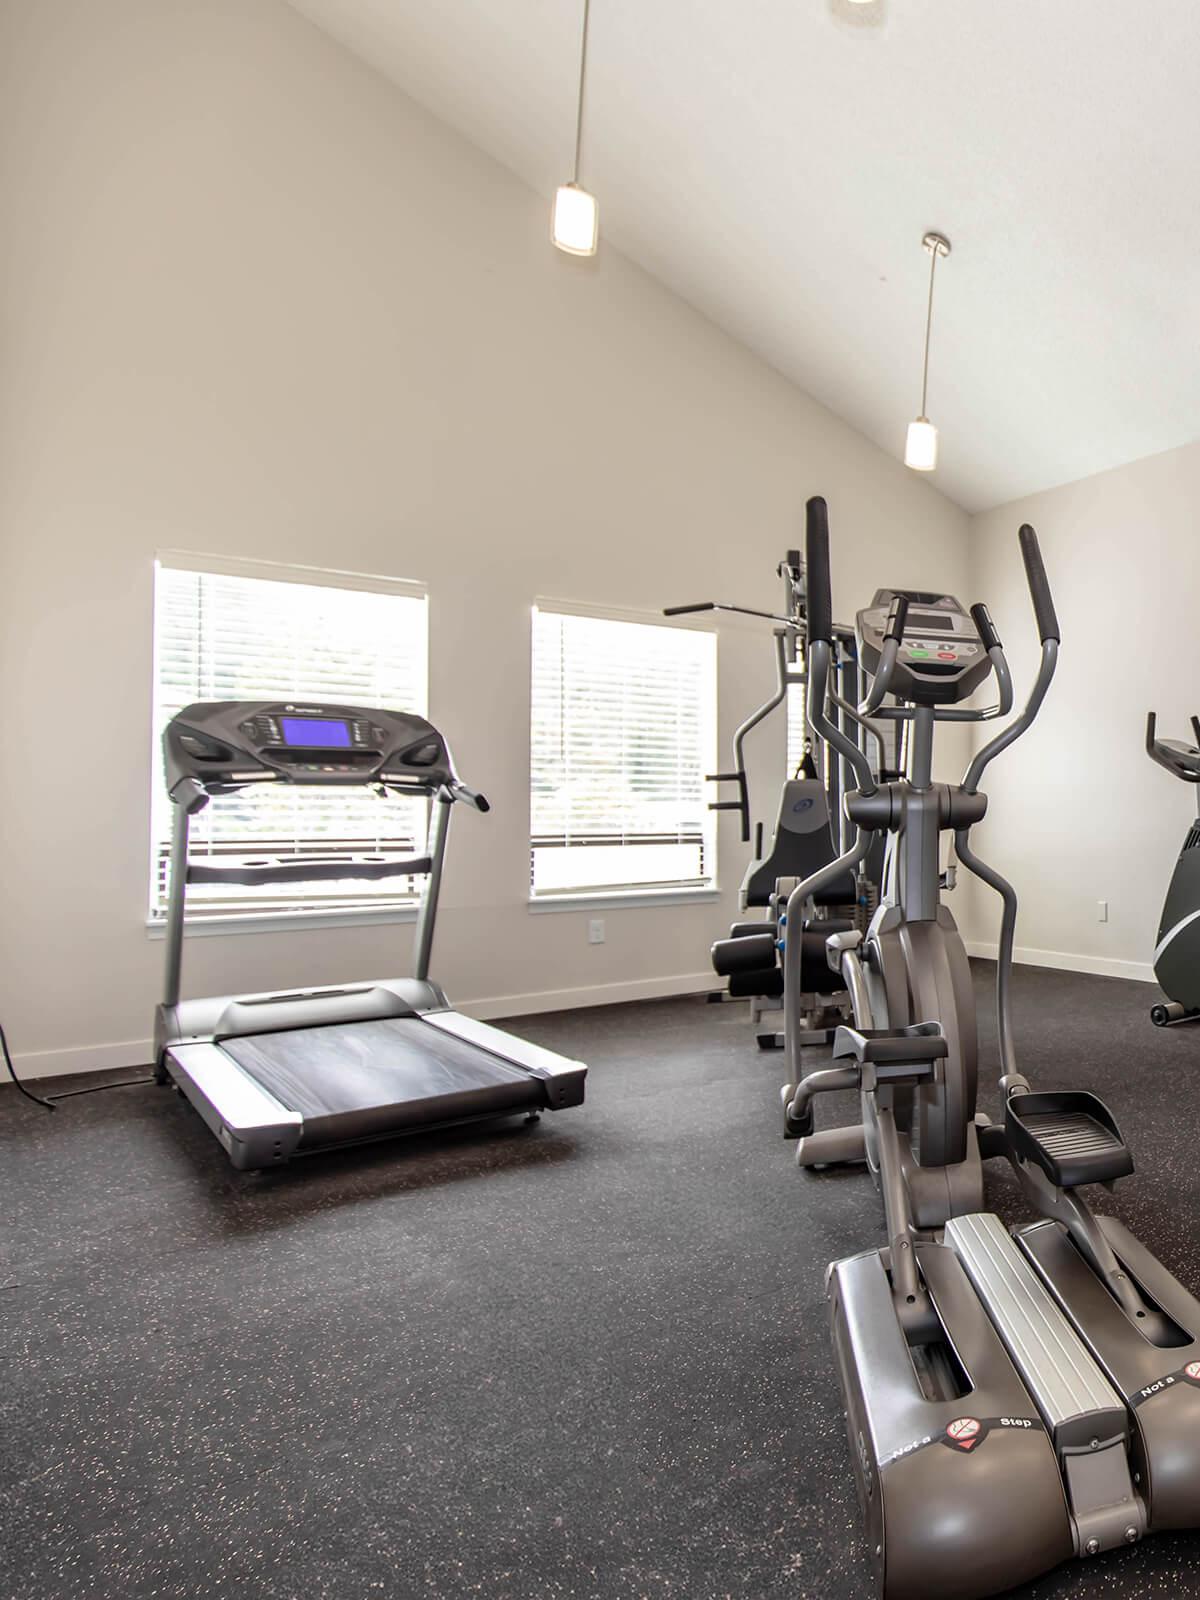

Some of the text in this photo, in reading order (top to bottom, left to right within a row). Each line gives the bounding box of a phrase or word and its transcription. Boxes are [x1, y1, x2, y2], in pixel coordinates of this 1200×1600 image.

[1140, 1380, 1165, 1397] Not
[1166, 1376, 1175, 1384] a
[892, 1441, 919, 1459] Not
[1000, 1418, 1032, 1428] Step
